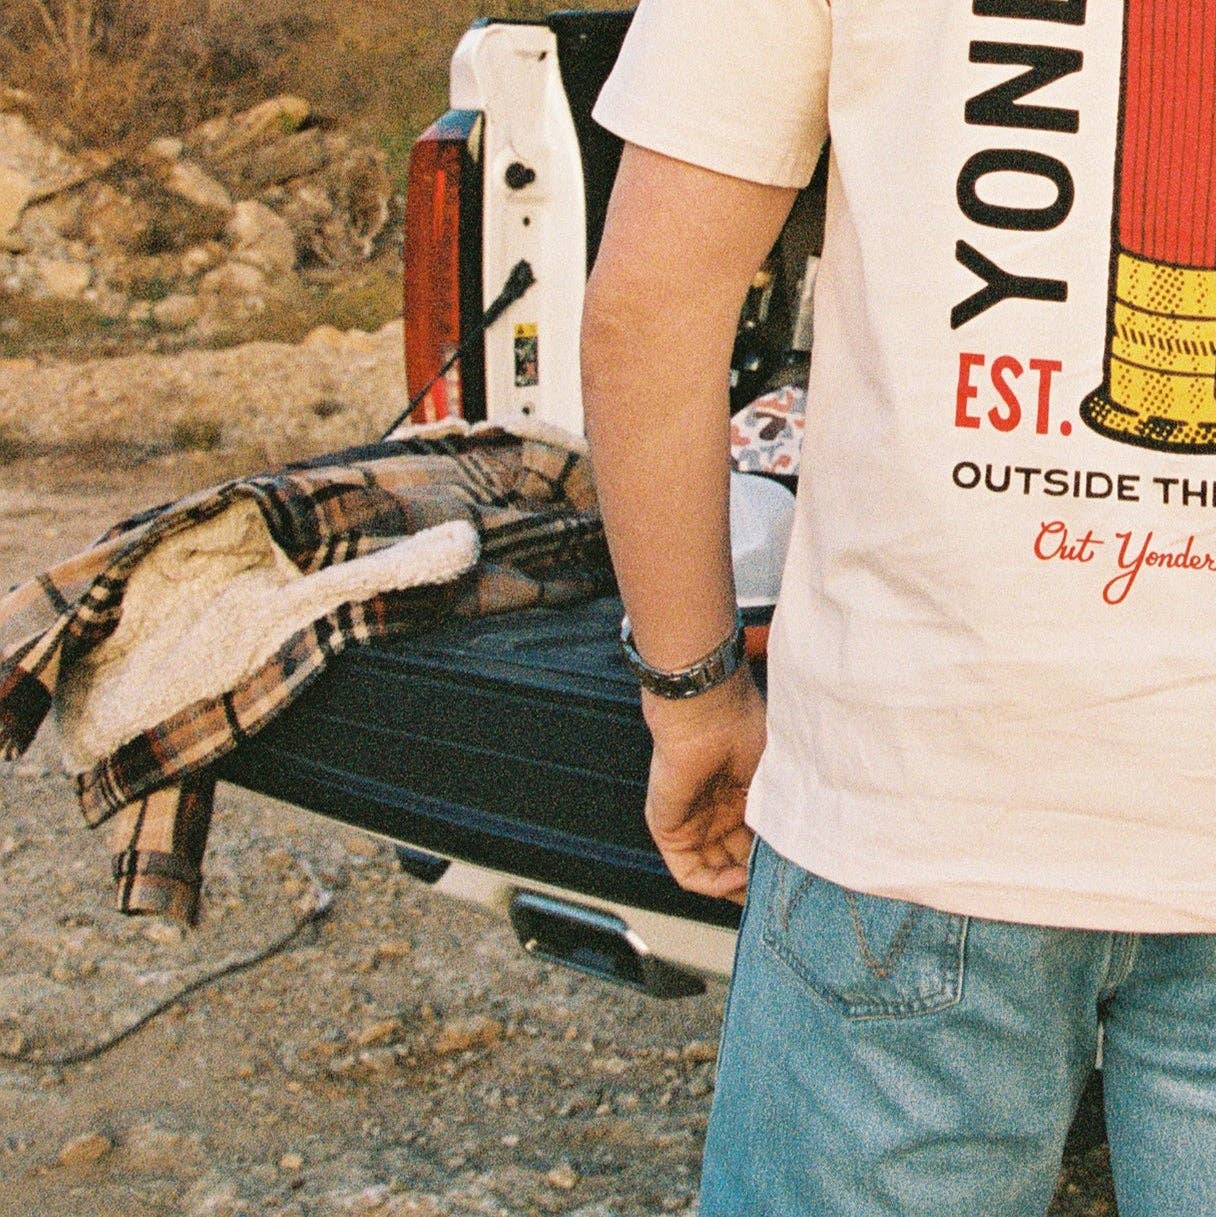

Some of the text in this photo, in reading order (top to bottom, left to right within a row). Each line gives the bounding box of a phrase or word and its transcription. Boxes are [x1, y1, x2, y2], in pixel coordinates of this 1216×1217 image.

[954, 351, 1073, 437] EST.
[951, 460, 1141, 503] OUTSIDE
[1033, 520, 1104, 564] Out
